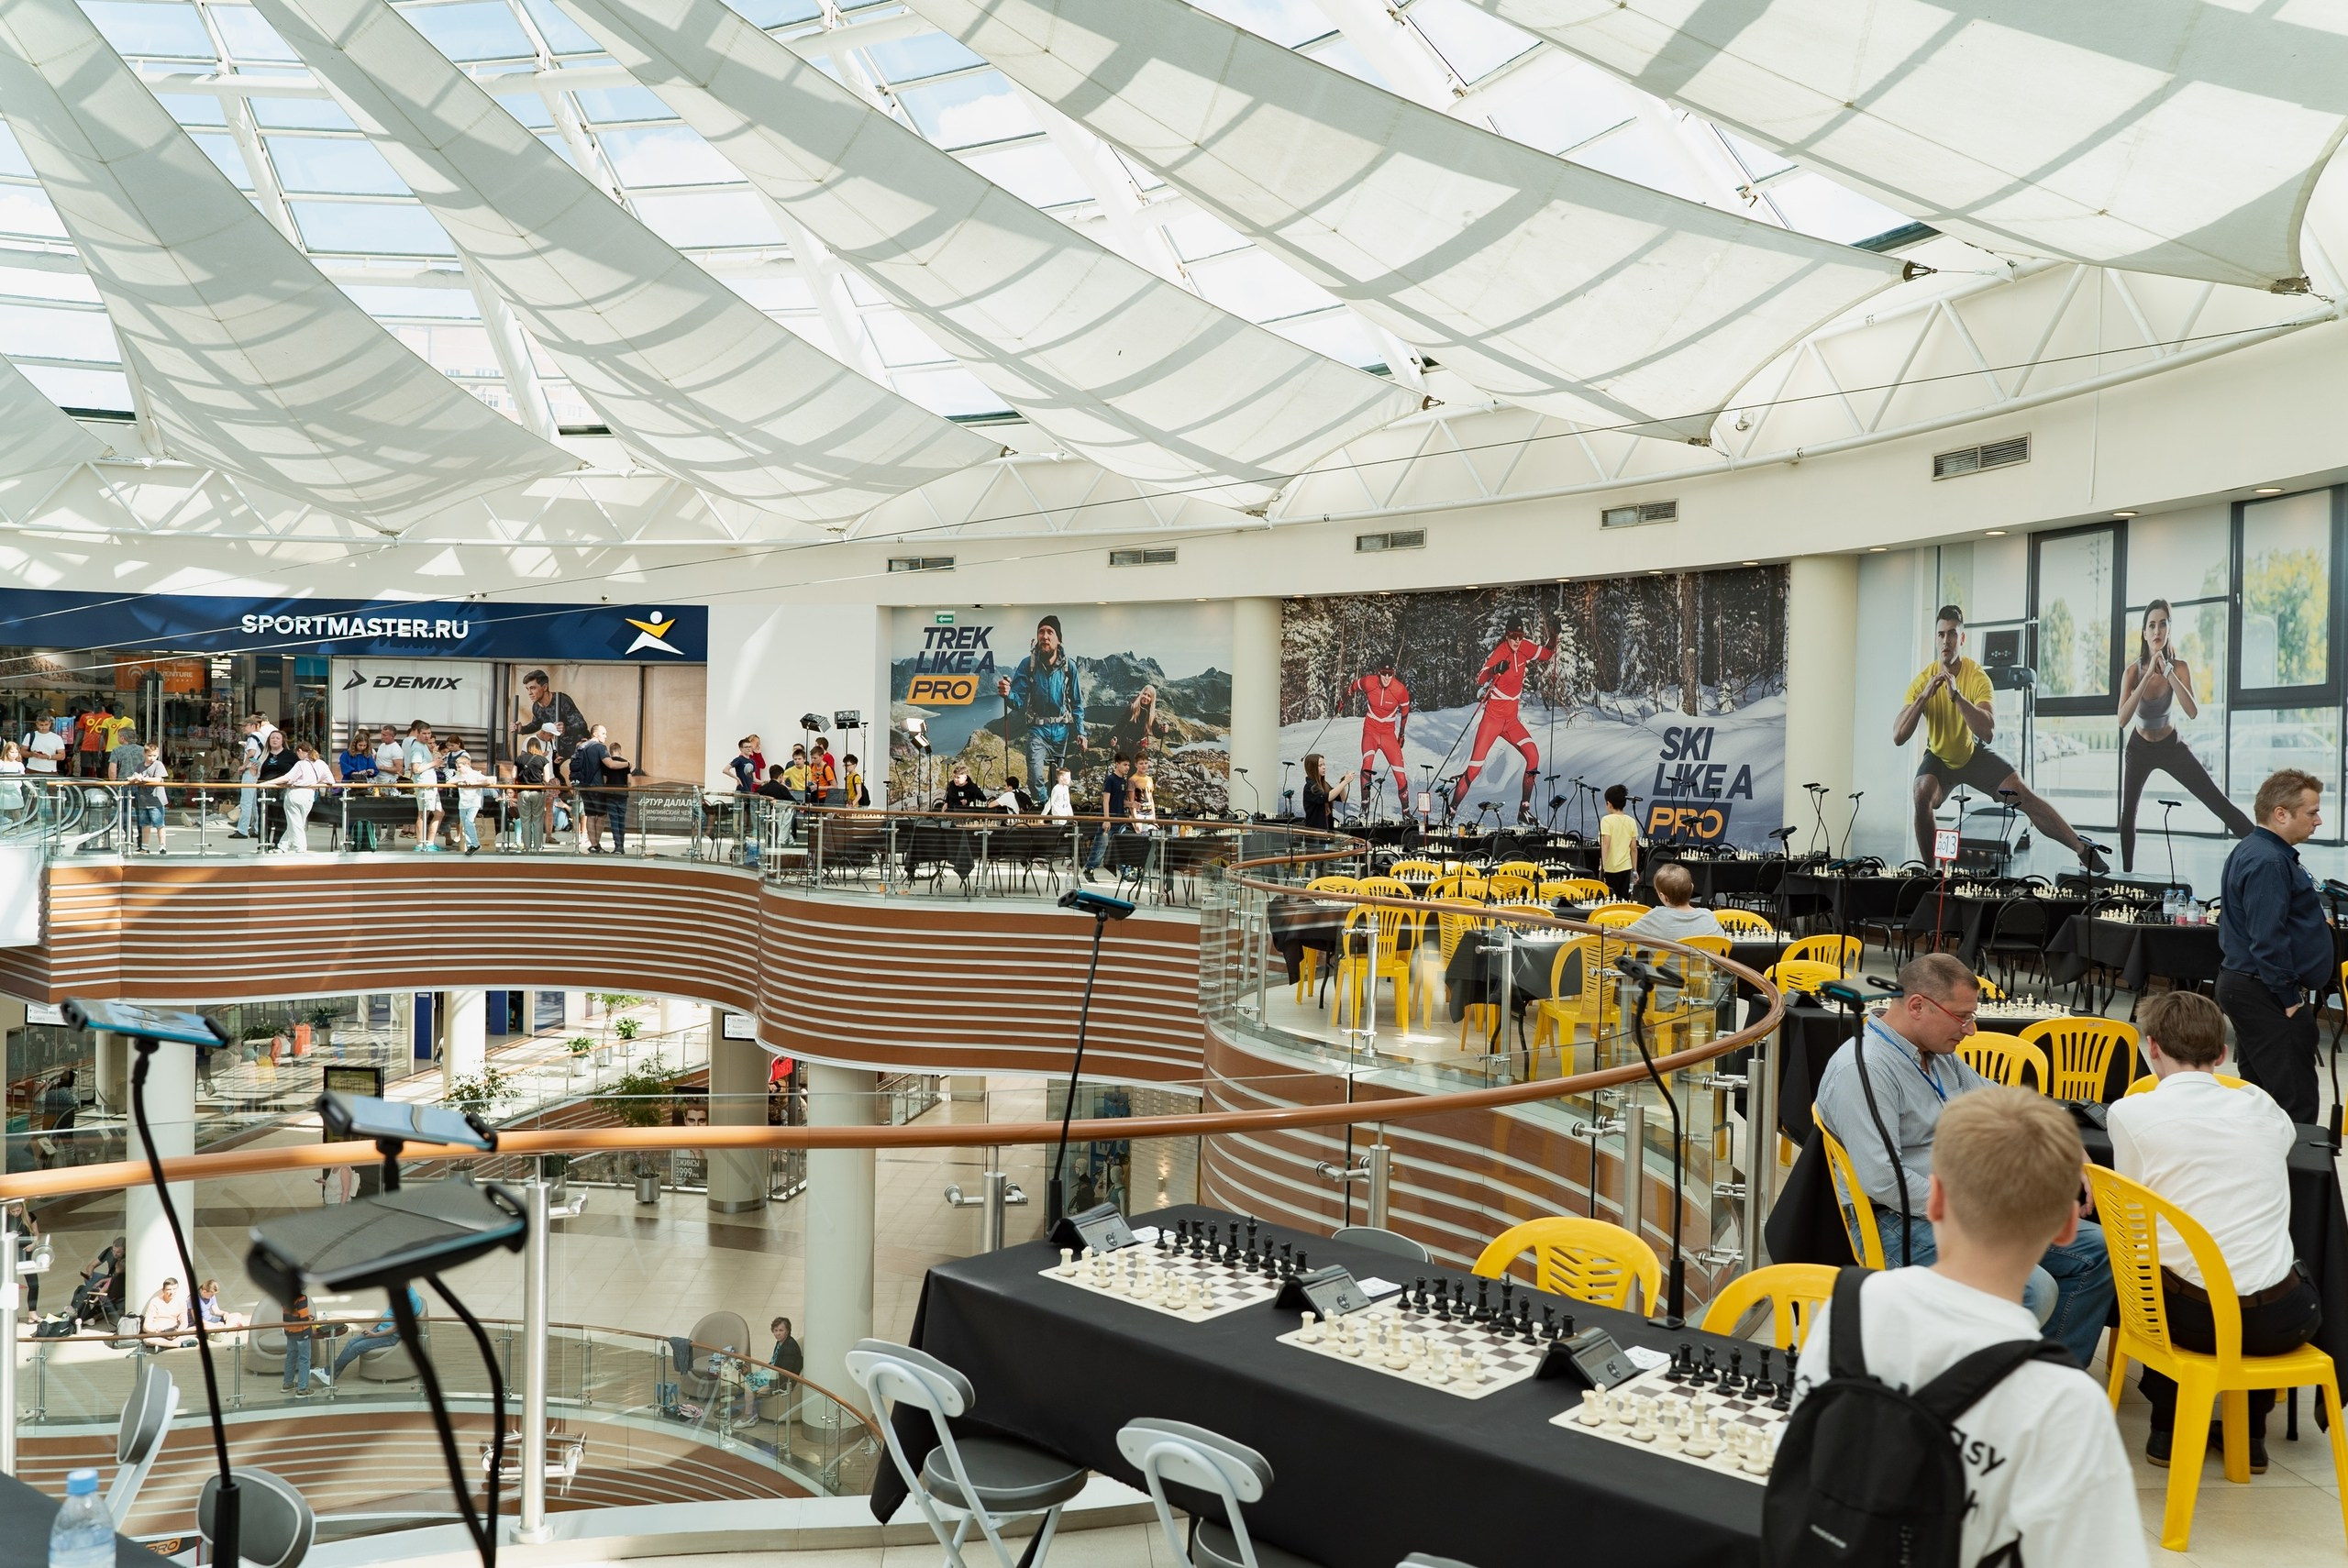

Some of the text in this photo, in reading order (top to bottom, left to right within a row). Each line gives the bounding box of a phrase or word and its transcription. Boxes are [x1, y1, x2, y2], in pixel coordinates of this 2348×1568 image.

[241, 613, 469, 639] SPORTMASTER.RU
[924, 626, 993, 649] TREK
[915, 651, 995, 673] LIKE A
[372, 676, 463, 690] DEMIX
[912, 680, 972, 700] PRO
[1659, 726, 1715, 761] SKI
[1652, 762, 1753, 800] LIKE A
[1648, 806, 1723, 839] PRO
